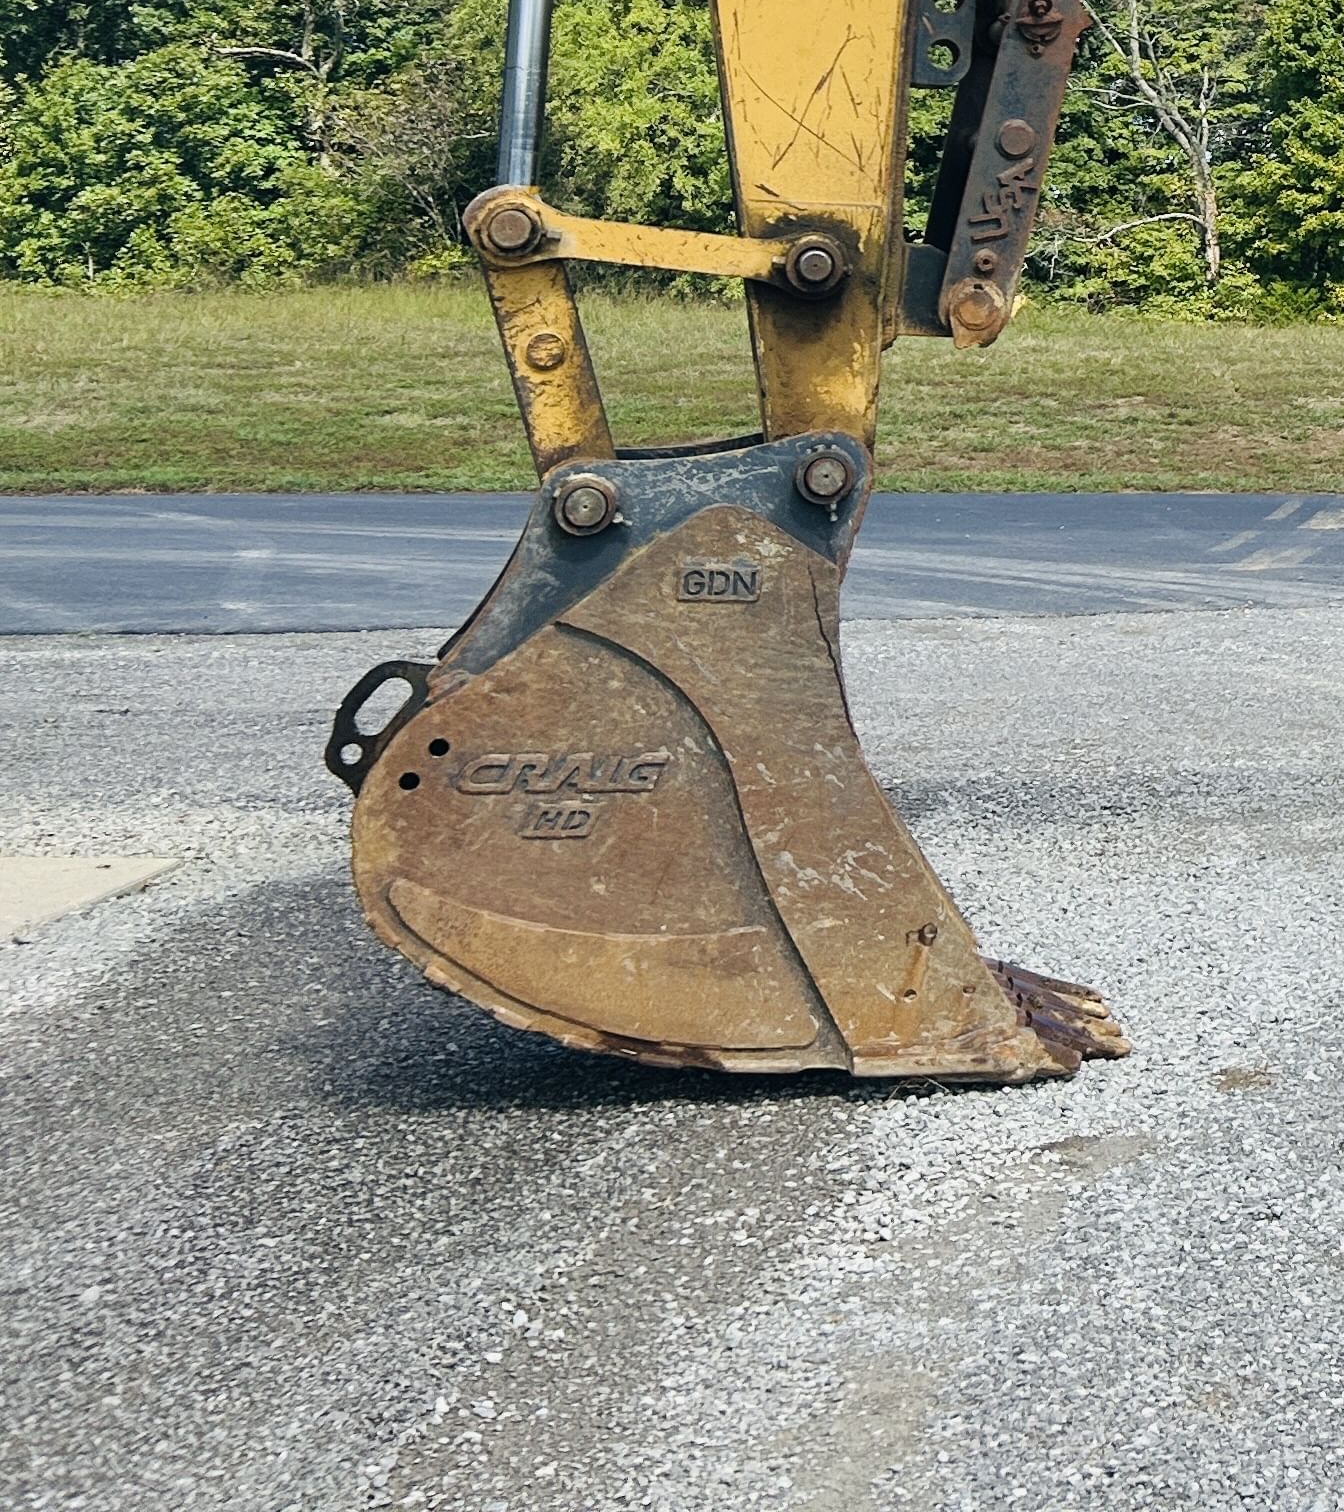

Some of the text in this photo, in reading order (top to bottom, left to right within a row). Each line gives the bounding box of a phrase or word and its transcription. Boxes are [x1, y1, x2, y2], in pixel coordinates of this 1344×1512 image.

[682, 569, 757, 597] GDN
[462, 753, 669, 792] CRAIG
[532, 808, 592, 832] HD
